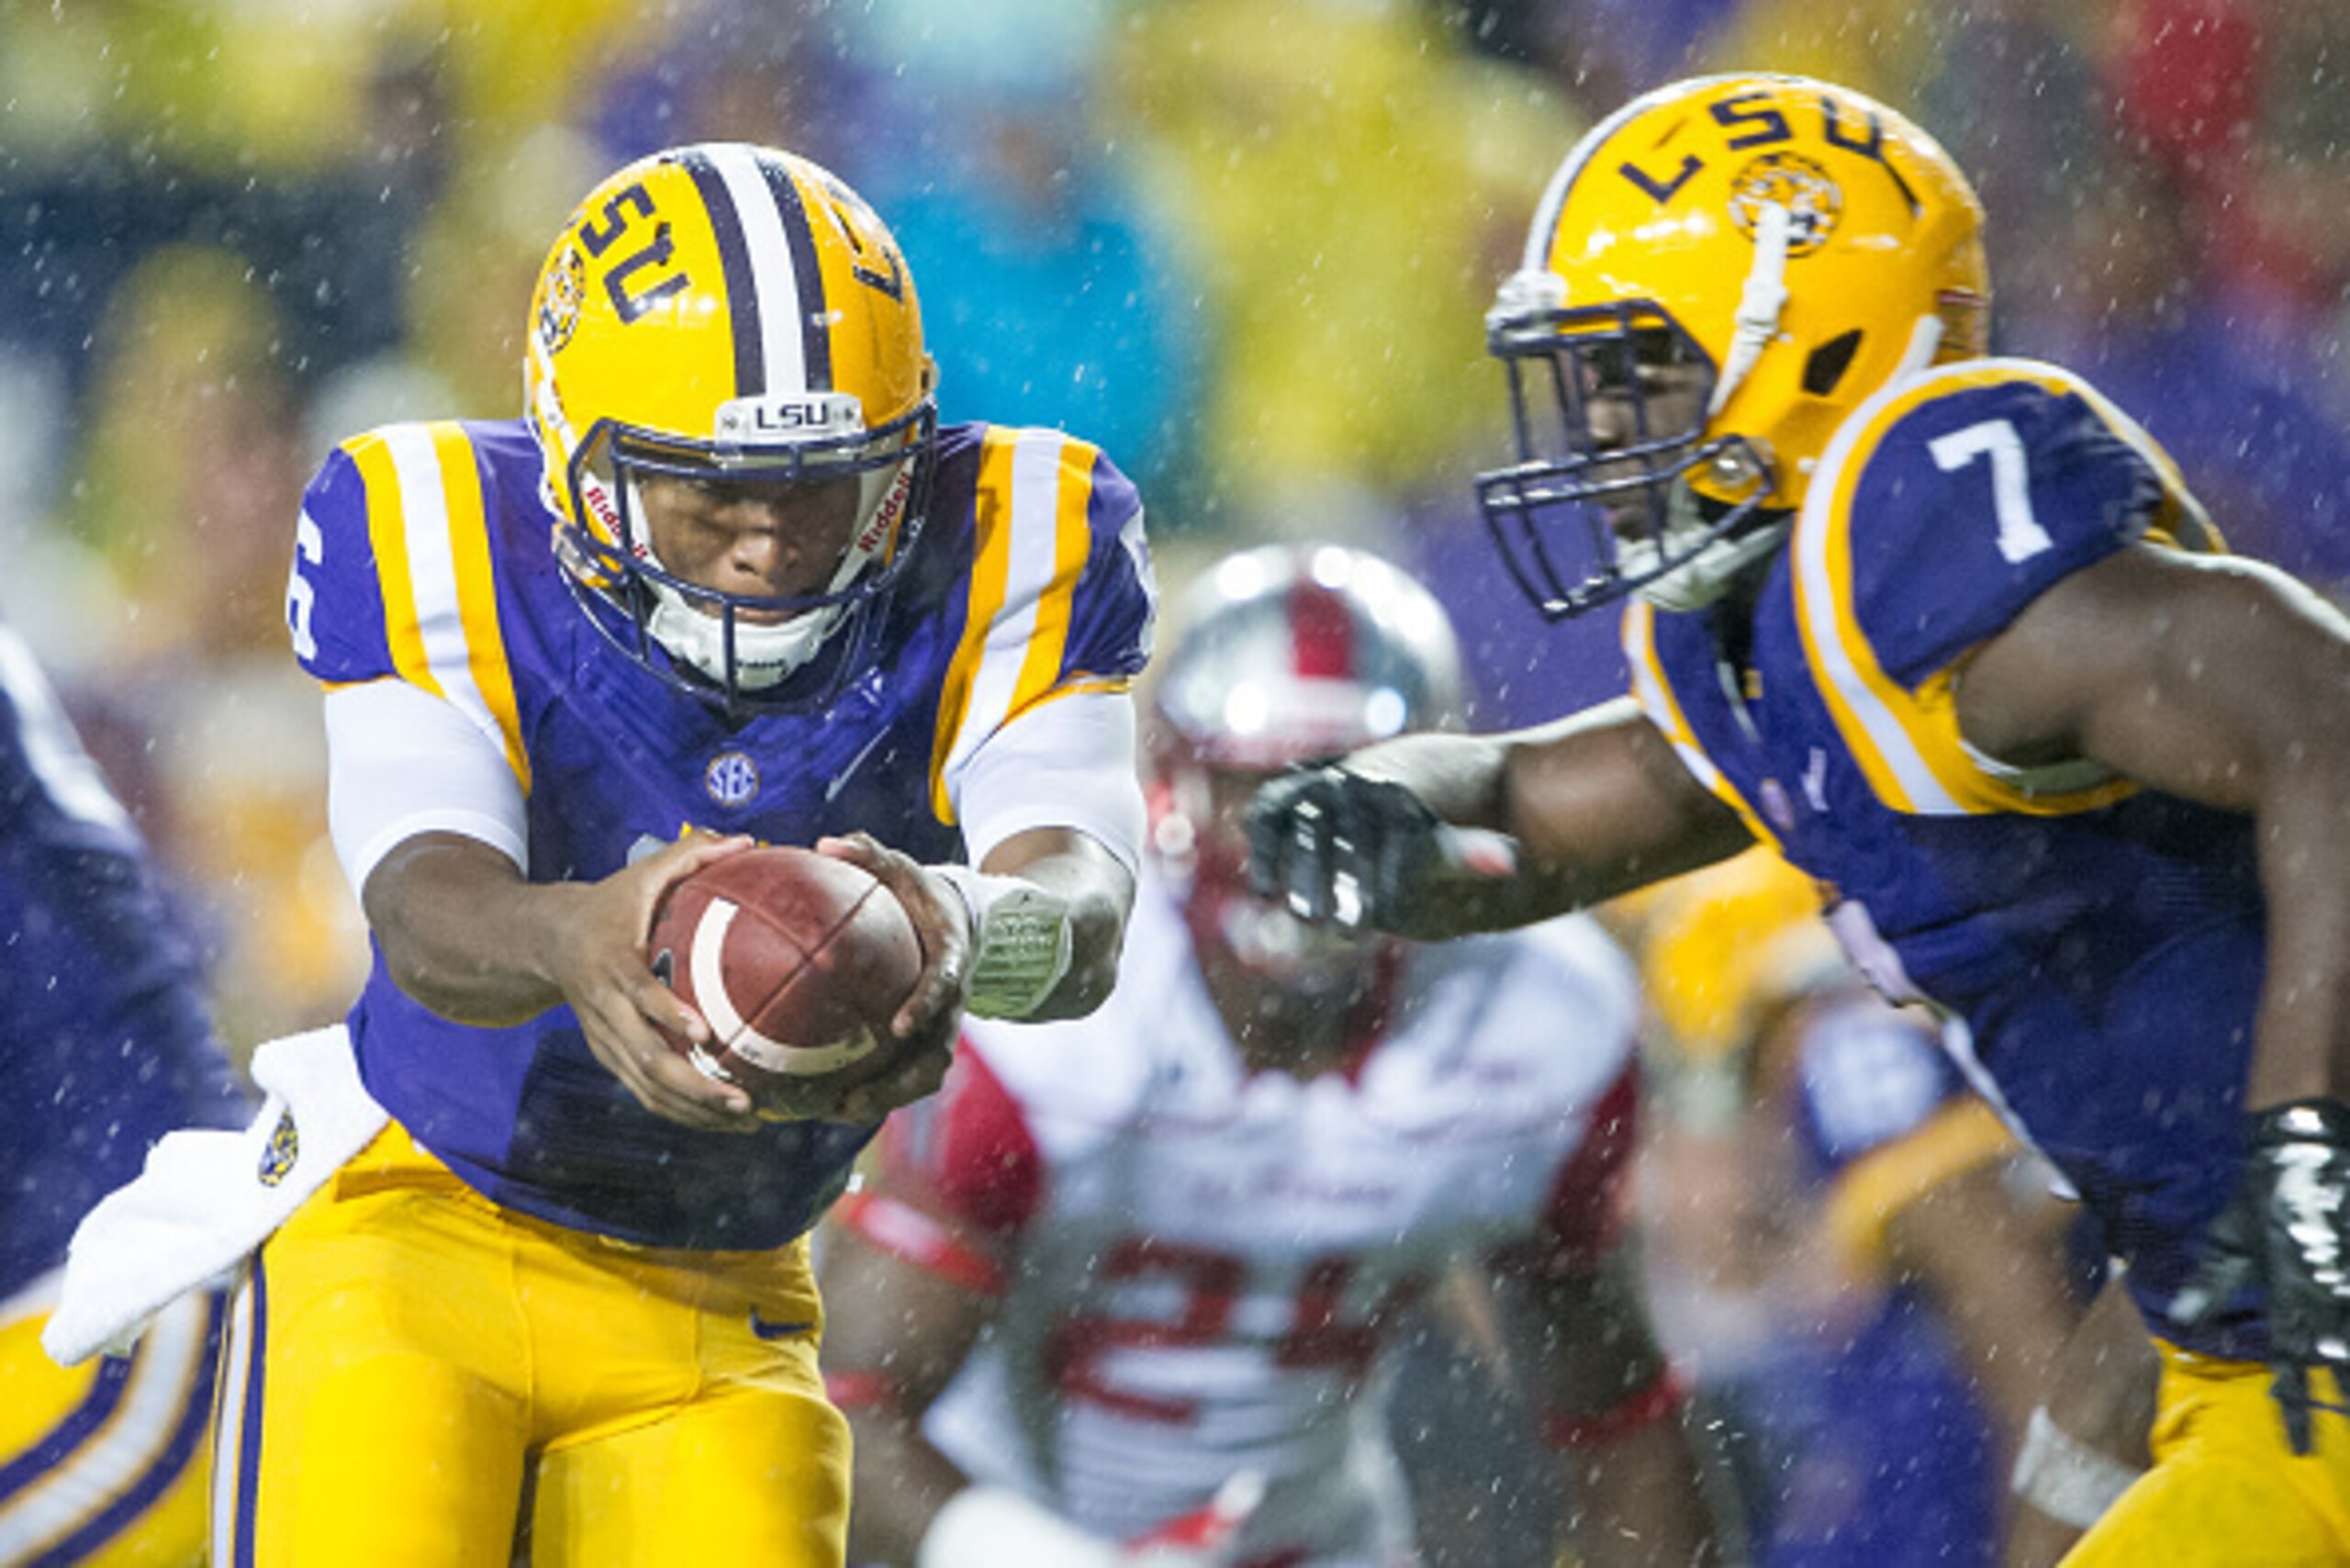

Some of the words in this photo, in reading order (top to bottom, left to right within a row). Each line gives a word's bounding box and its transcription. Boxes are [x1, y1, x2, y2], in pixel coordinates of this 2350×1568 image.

[1618, 93, 1884, 204] LSU
[756, 401, 828, 430] LSU
[1926, 419, 2054, 564] 7
